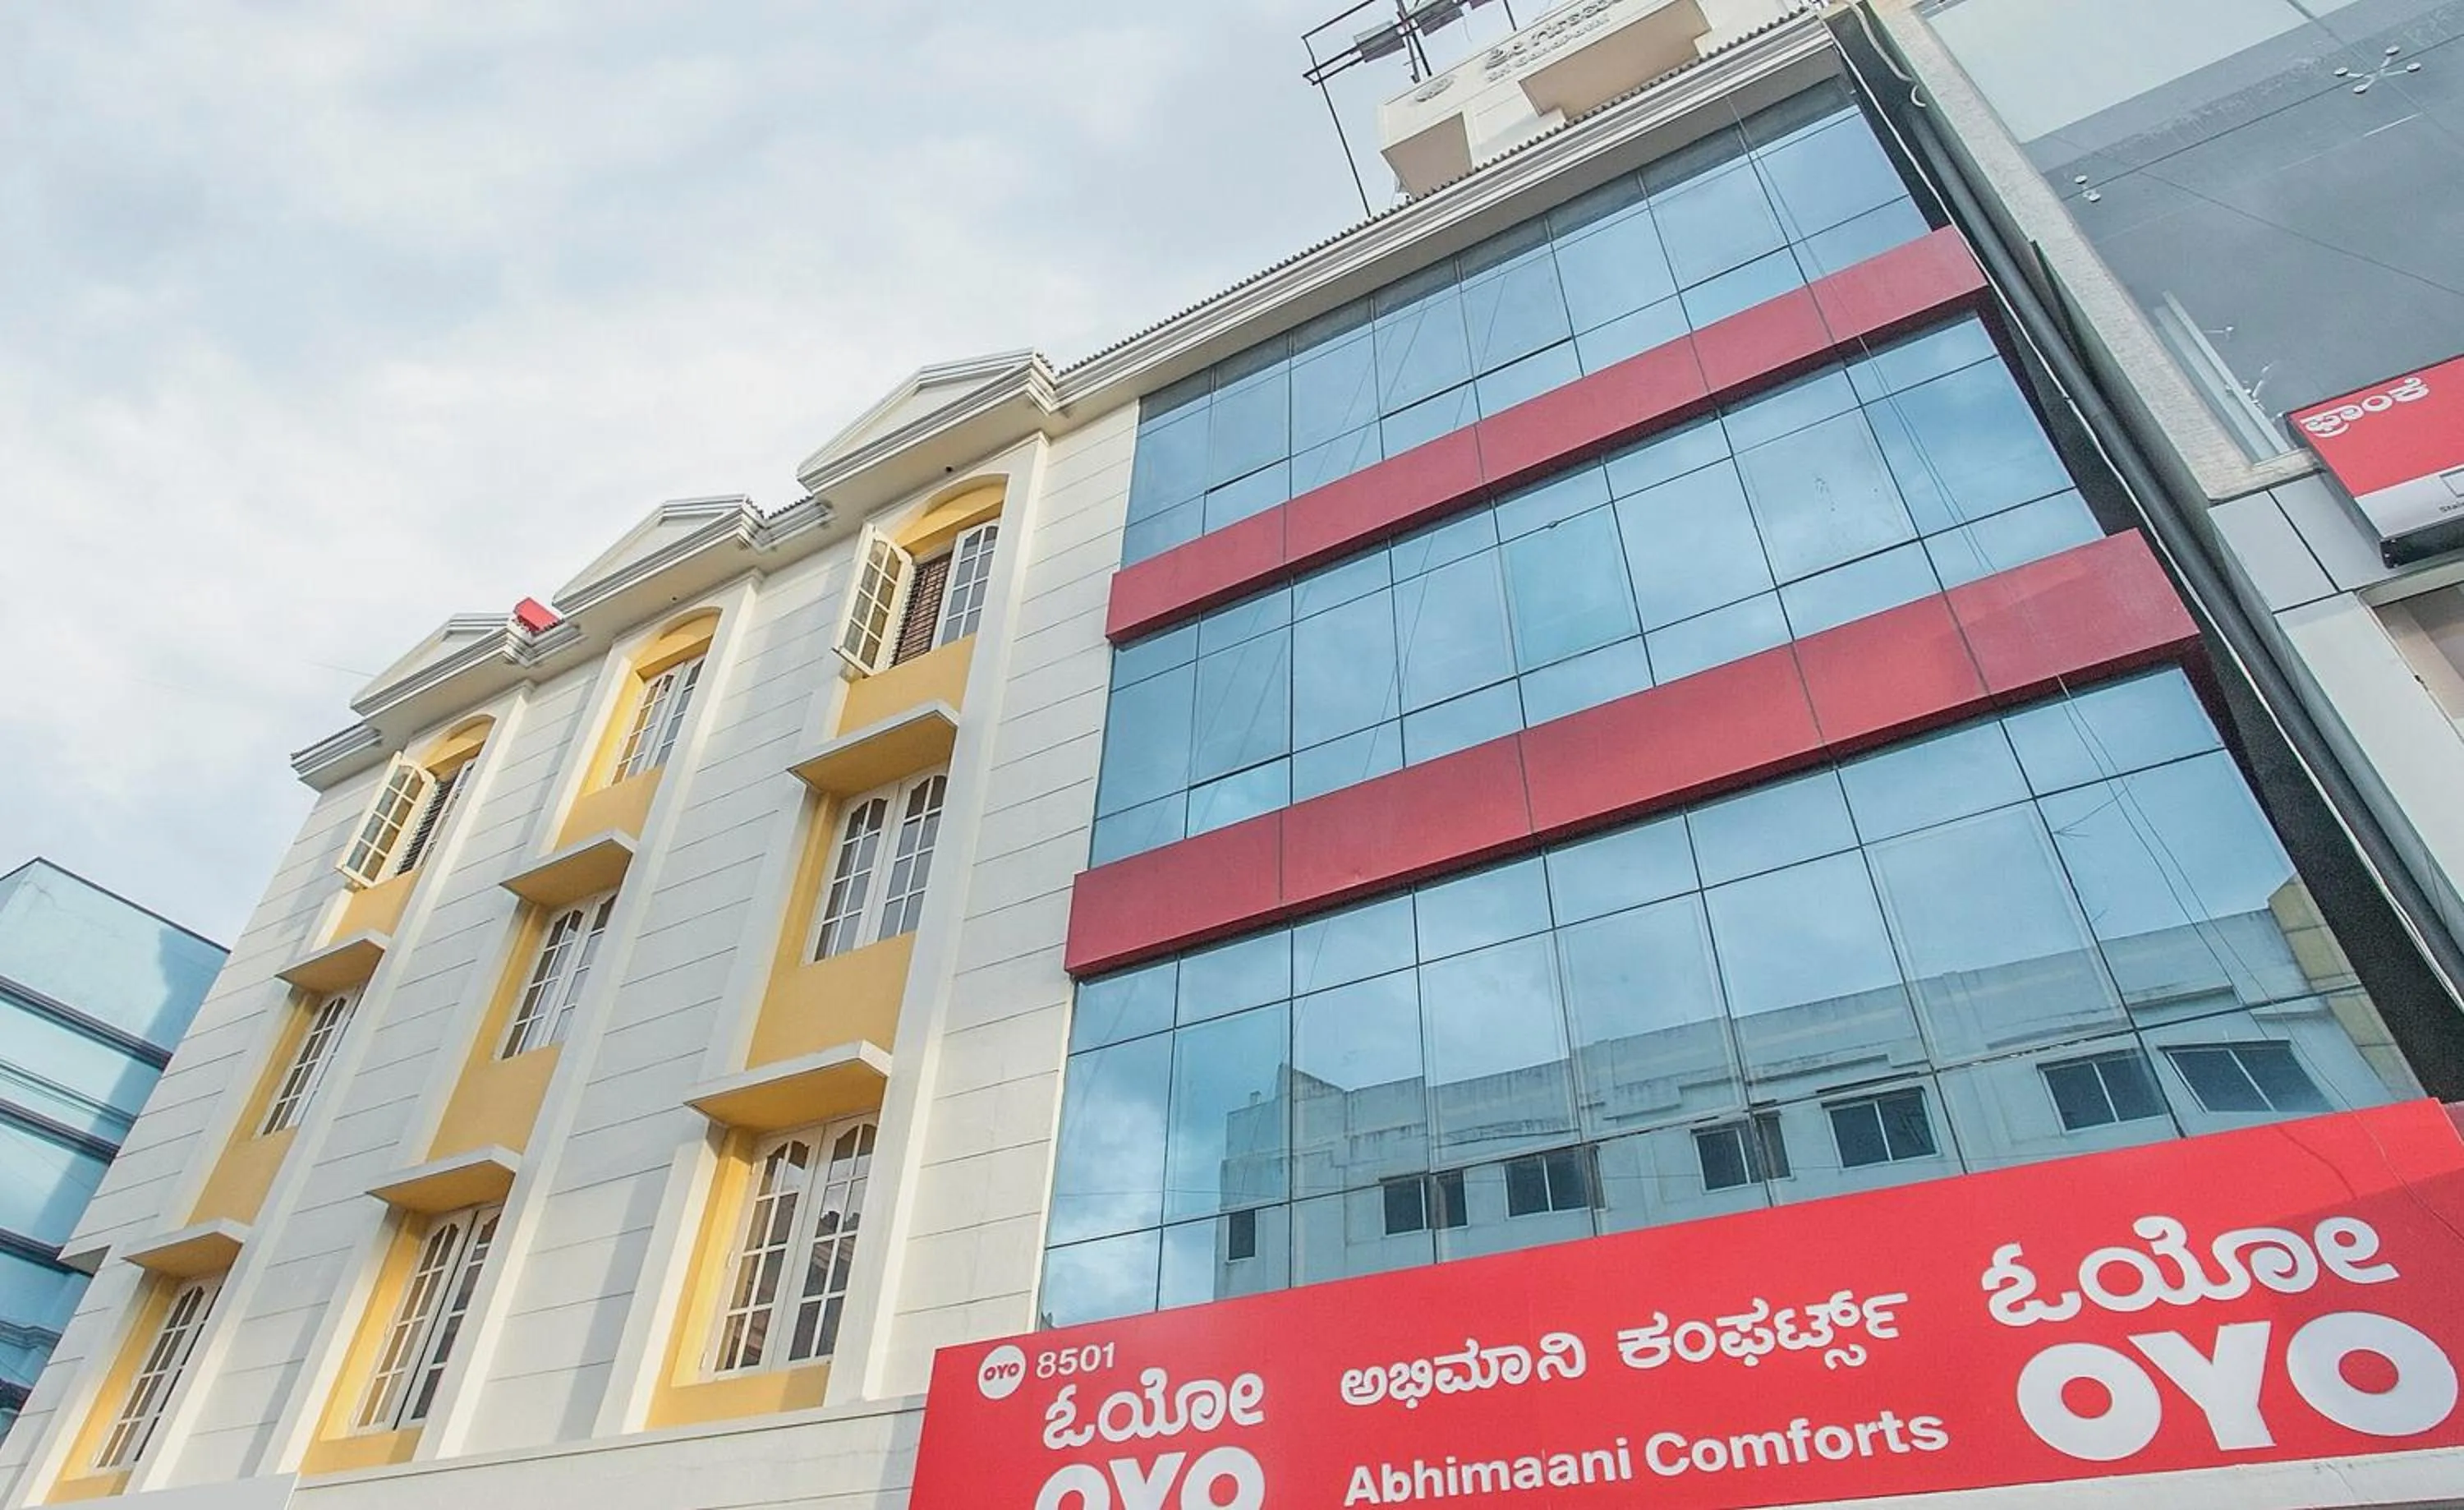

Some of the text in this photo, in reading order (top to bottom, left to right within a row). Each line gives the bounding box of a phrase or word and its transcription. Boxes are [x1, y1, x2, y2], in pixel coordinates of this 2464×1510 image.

[1980, 1215, 2400, 1327] ಓಯೋ
[983, 1362, 1020, 1381] OYO
[1036, 1342, 1115, 1379] 8501
[1340, 1331, 1587, 1409] ಅಭಿಮಾನಿ
[2016, 1311, 2459, 1462] OYO
[1042, 1367, 1265, 1450] ಓಯೋ
[1034, 1446, 1266, 1510] OYO
[1343, 1410, 1949, 1507] Abhimaani Comforts
